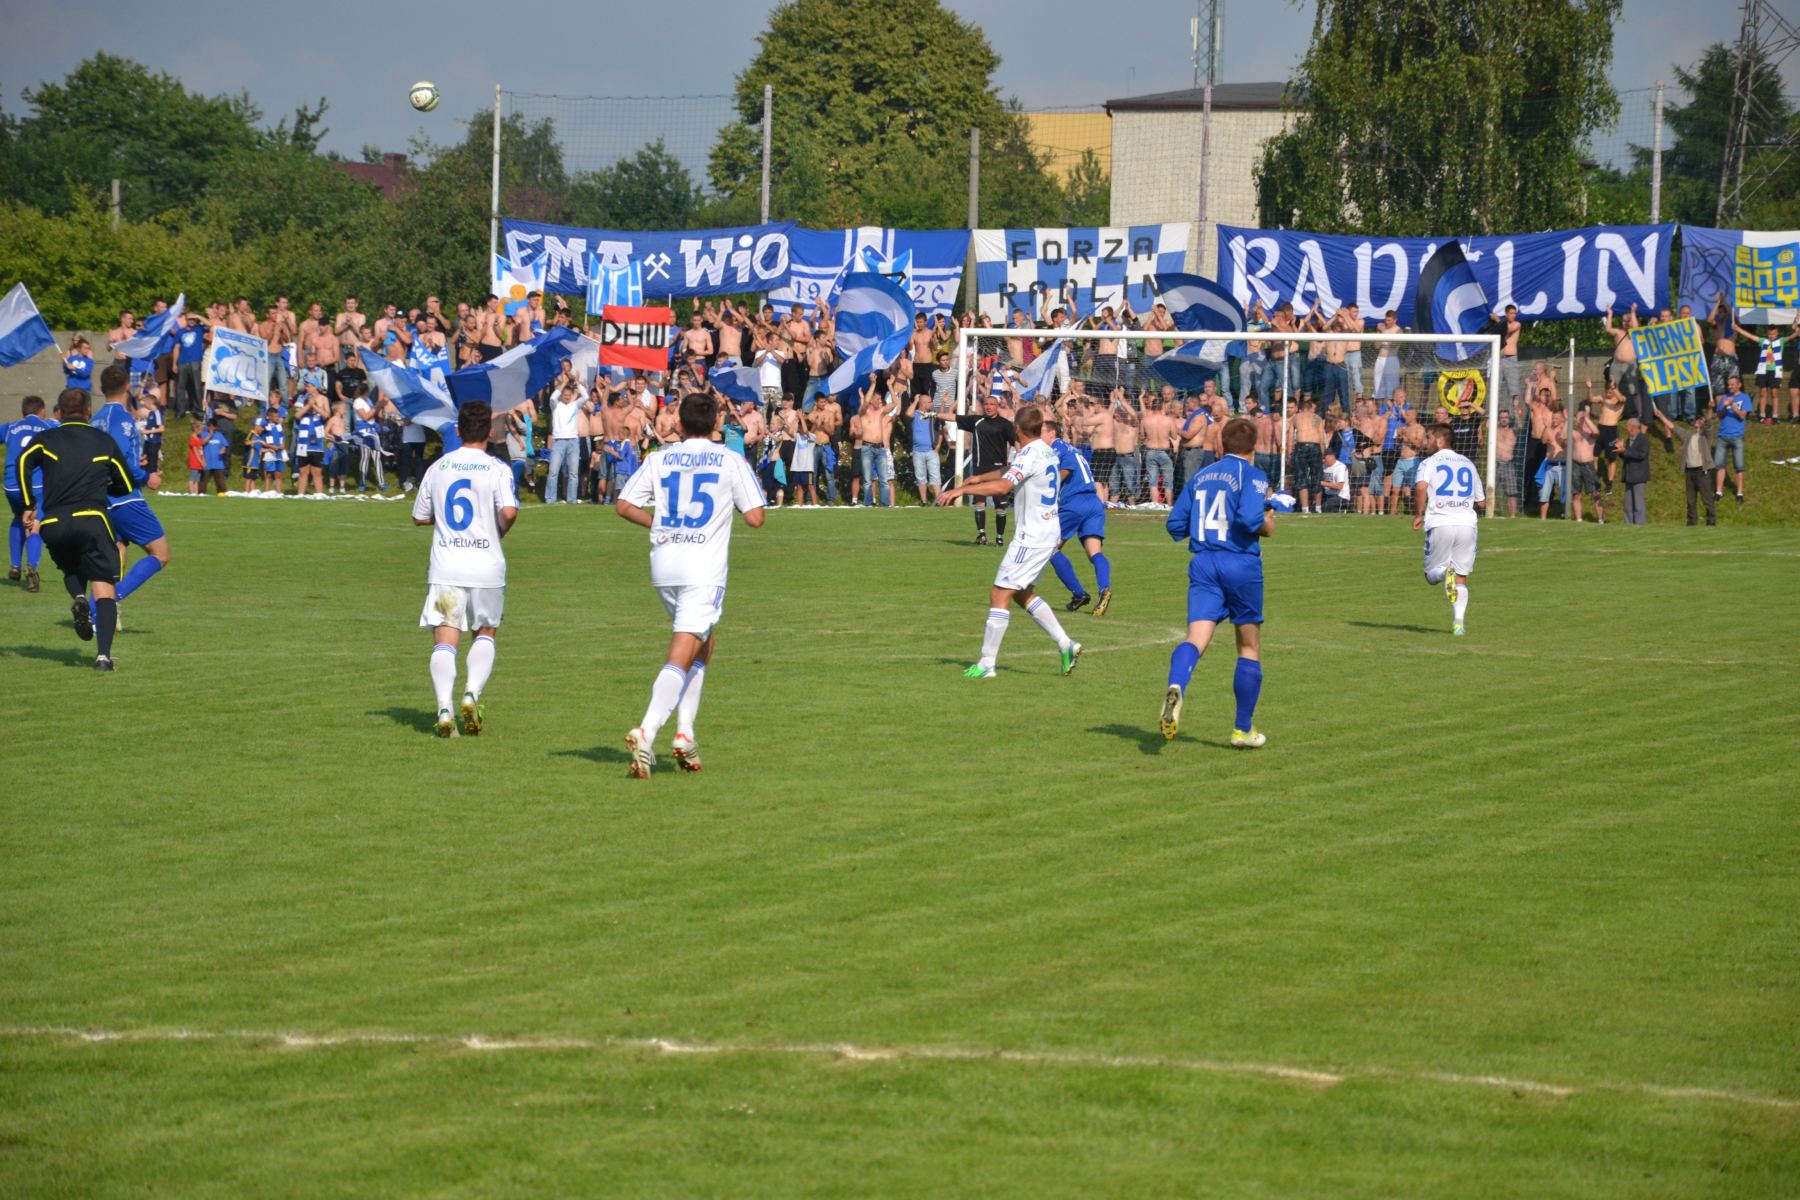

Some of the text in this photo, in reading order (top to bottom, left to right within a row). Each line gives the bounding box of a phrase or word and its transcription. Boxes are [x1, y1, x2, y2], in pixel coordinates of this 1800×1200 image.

[1011, 237, 1153, 267] FORZA
[1735, 245, 1773, 267] EL
[796, 280, 821, 300] 19
[999, 274, 1162, 309] RADLIN
[601, 319, 666, 350] DHW
[1040, 465, 1058, 506] 3
[1435, 464, 1473, 497] 29
[444, 478, 474, 531] 6
[661, 471, 720, 528] 15
[1195, 490, 1229, 541] 14
[449, 537, 490, 549] HELIMED
